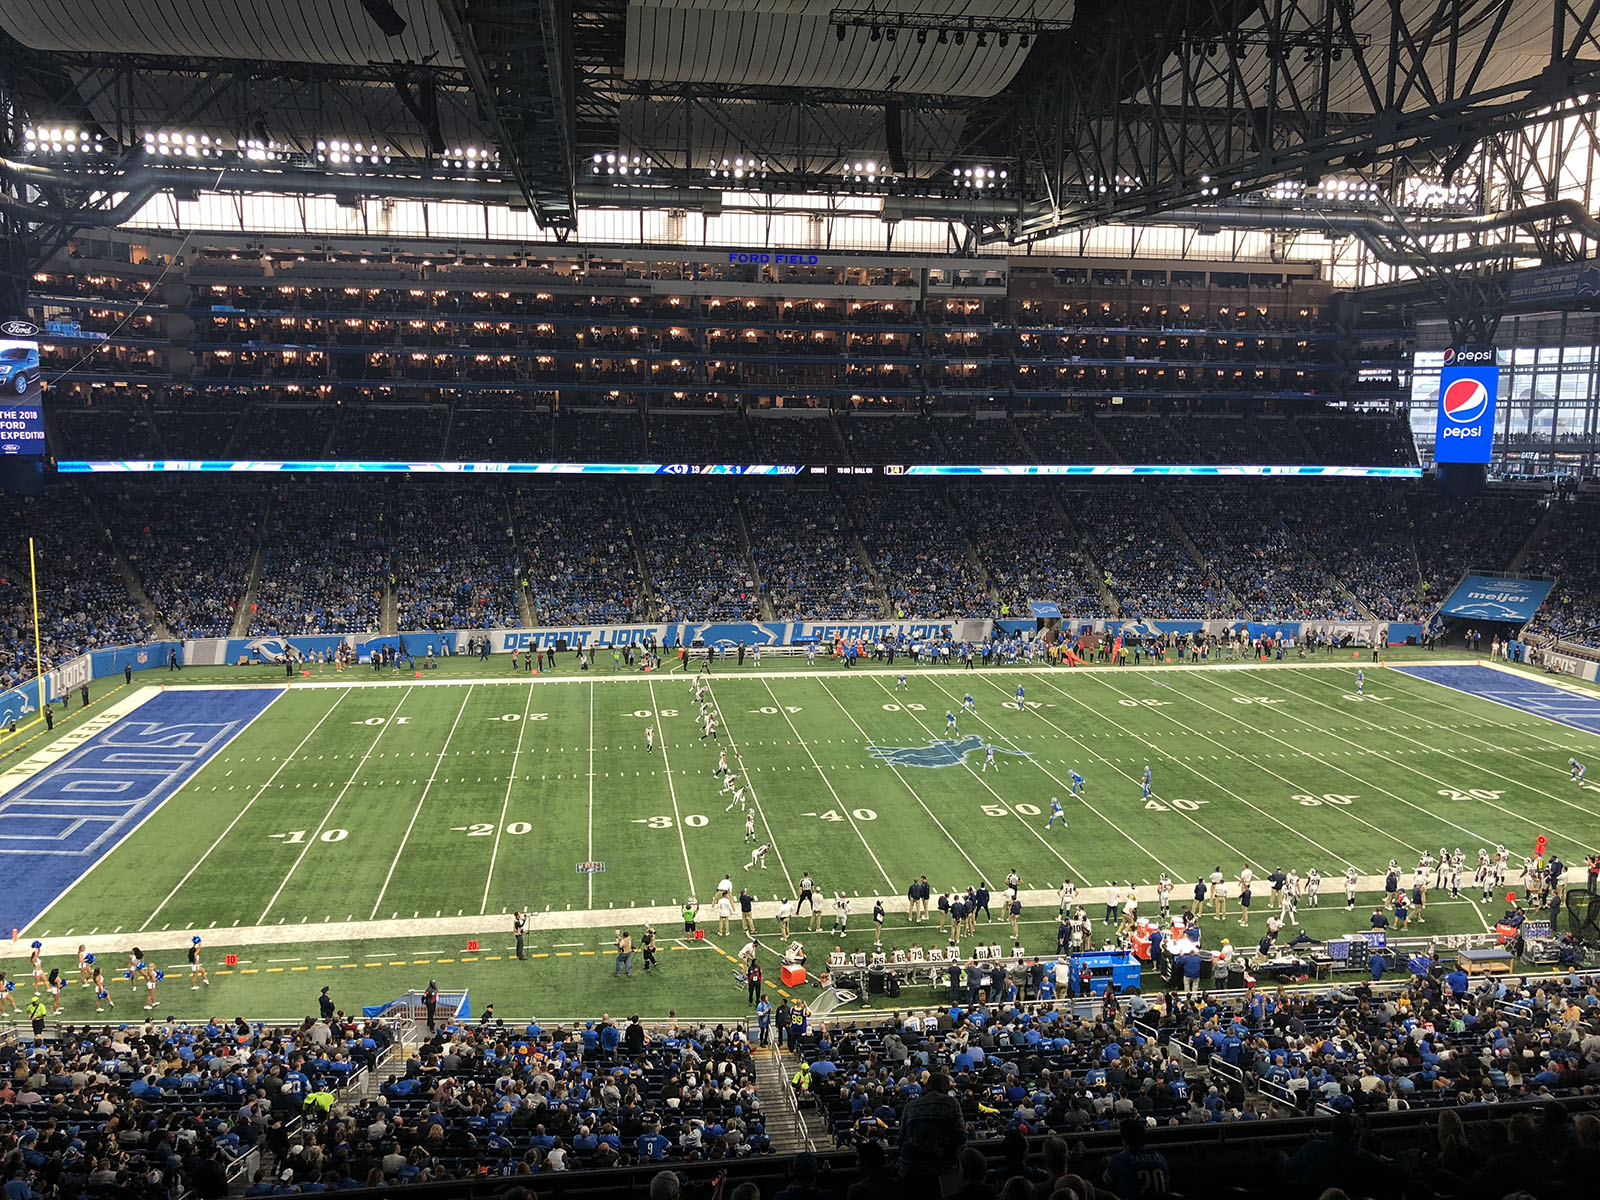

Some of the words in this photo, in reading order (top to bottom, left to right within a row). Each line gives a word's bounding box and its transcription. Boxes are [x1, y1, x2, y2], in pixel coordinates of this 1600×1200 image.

[729, 252, 770, 264] FORD
[775, 254, 819, 265] FIELD
[8, 322, 32, 334] Ford
[1457, 350, 1492, 362] pepsi
[0, 411, 17, 420] THE
[19, 411, 38, 420] 2018
[0, 421, 26, 430] FORD
[1443, 425, 1482, 439] pepsi
[1521, 451, 1534, 459] GATE
[1533, 452, 1540, 461] A
[691, 465, 700, 474] 13
[735, 465, 741, 474] 3
[776, 465, 796, 474] 15:00
[1467, 592, 1530, 603] meijer
[811, 624, 892, 642] DETROIT
[900, 624, 953, 641] LIONS
[503, 630, 592, 650] DETROIT
[600, 628, 658, 648] LIONS
[1543, 653, 1577, 674] LIONS
[1291, 793, 1354, 806] 30
[1437, 788, 1501, 801] 20
[980, 803, 1042, 817] 50
[1144, 798, 1201, 812] 40
[819, 808, 878, 822] 40
[648, 814, 709, 829] 30
[466, 821, 533, 836] 20
[282, 829, 349, 844] 10
[1064, 887, 1073, 895] 14
[1072, 924, 1081, 933] 10
[695, 930, 704, 939] 30
[467, 941, 479, 951] 20
[226, 955, 237, 965] 10
[911, 949, 922, 960] 79
[931, 952, 941, 962] 55
[949, 950, 959, 959] 70
[978, 950, 987, 959] 81
[833, 956, 843, 965] 77
[791, 1014, 803, 1026] 99
[104, 1064, 115, 1073] 17
[1178, 1087, 1187, 1099] 15
[647, 1142, 653, 1155] 9
[503, 1166, 511, 1176] 81
